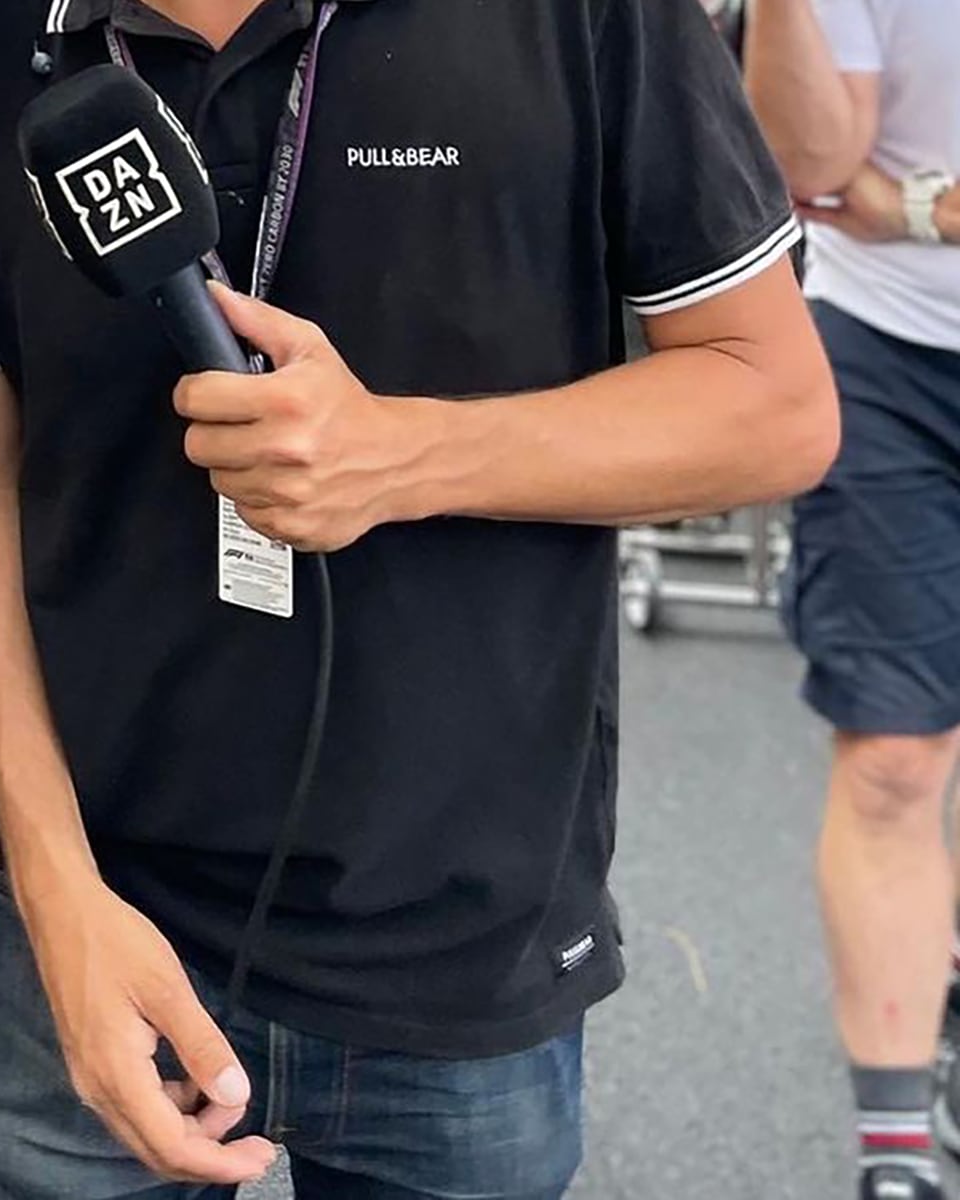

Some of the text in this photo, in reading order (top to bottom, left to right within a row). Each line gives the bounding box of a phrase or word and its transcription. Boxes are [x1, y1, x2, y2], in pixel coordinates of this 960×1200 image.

[346, 145, 461, 168] PULL&BEAR
[267, 192, 286, 243] CARBON
[278, 144, 294, 175] 2030
